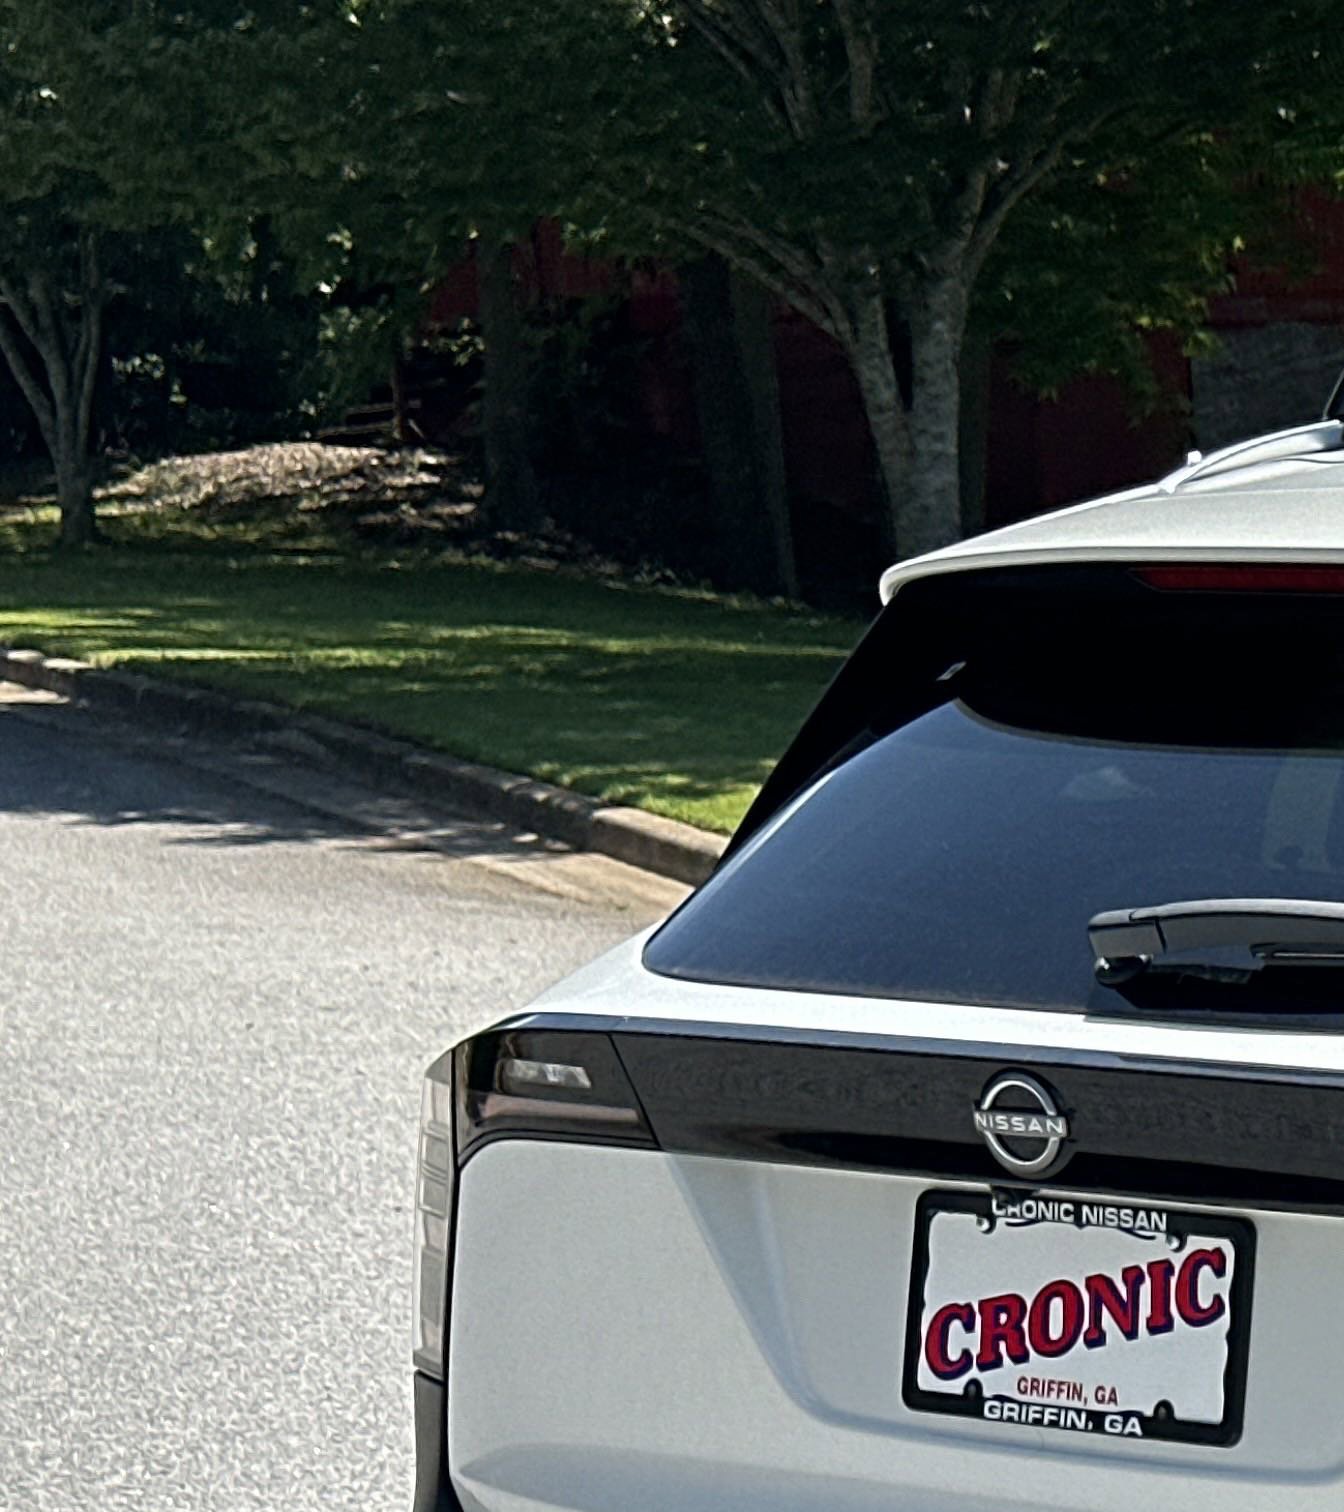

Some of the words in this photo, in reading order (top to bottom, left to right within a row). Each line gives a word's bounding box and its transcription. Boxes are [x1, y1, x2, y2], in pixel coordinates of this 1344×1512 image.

[974, 1110, 1064, 1134] NISSAN
[1081, 1204, 1167, 1232] NISSAN
[924, 1247, 1227, 1380] CRONIC
[1016, 1375, 1089, 1407] GRIFFIN,
[1094, 1384, 1119, 1406] GA
[983, 1400, 1094, 1431] GRIFFIN,
[1103, 1414, 1144, 1437] GA
